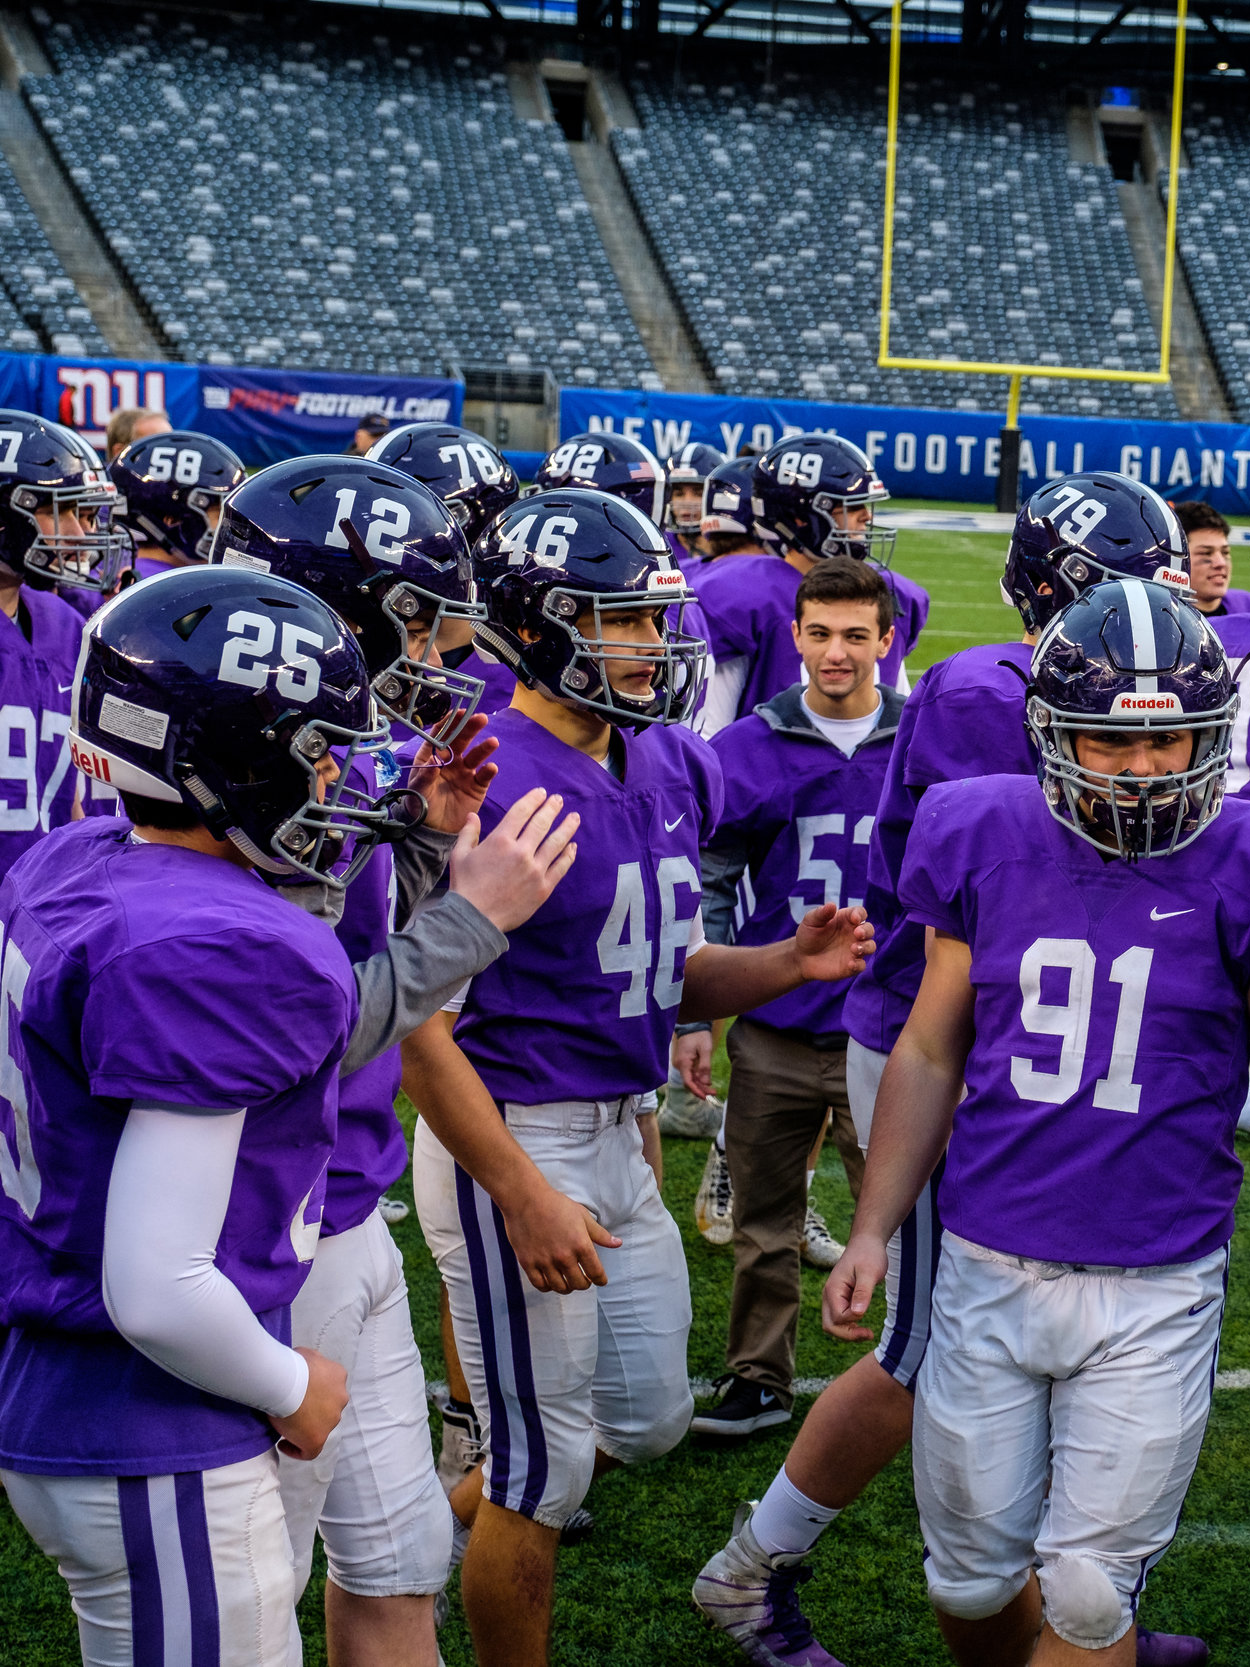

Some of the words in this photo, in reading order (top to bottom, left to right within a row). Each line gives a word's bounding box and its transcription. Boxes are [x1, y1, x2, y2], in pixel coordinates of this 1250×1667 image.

[149, 446, 203, 486] 58
[438, 442, 504, 490] 78
[548, 443, 605, 480] 92
[588, 415, 692, 460] NEW
[866, 430, 1085, 480] FOOTBALL
[777, 452, 823, 489] 89
[324, 488, 411, 566] 12
[498, 514, 579, 569] 46
[1045, 486, 1107, 544] 79
[1162, 570, 1189, 586] Riddell
[217, 610, 323, 703] 25
[1121, 698, 1175, 709] Riddell
[0, 704, 72, 834] 97
[71, 743, 111, 783] dell
[596, 855, 702, 1018] 46
[1010, 937, 1155, 1114] 91
